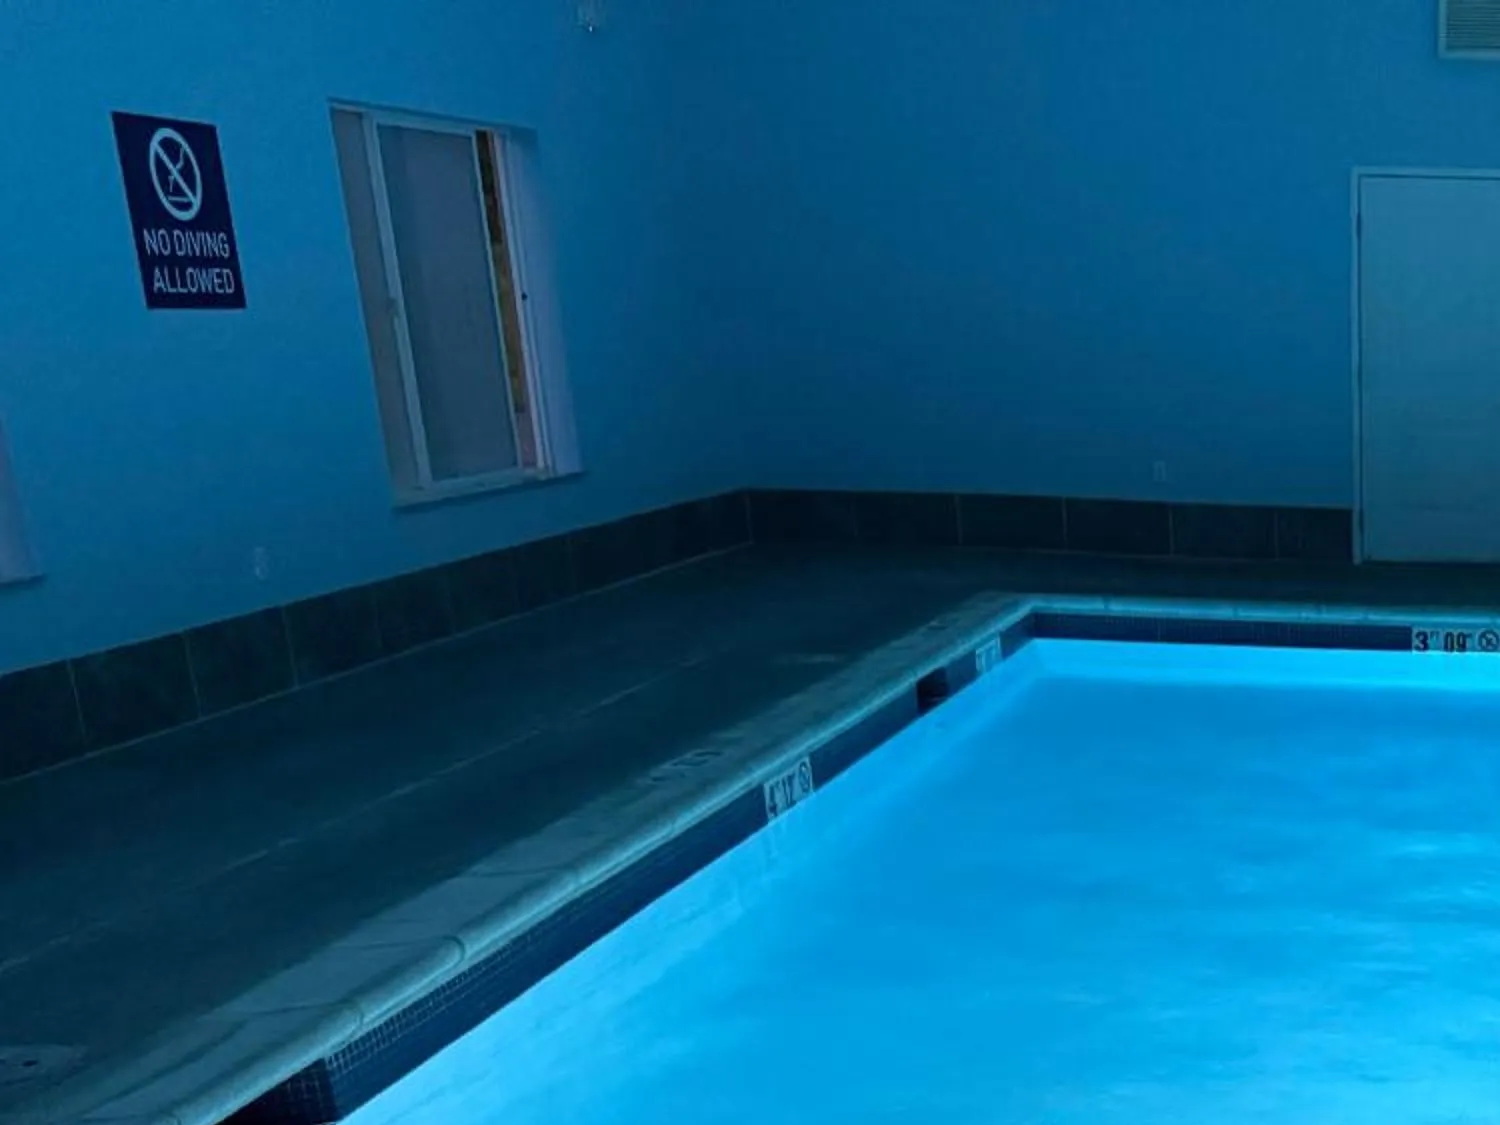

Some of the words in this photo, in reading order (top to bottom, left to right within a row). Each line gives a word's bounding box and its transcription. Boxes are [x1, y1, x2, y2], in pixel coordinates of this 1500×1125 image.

[143, 228, 170, 256] NO
[173, 229, 230, 258] DIVING
[153, 265, 235, 294] ALLOWED
